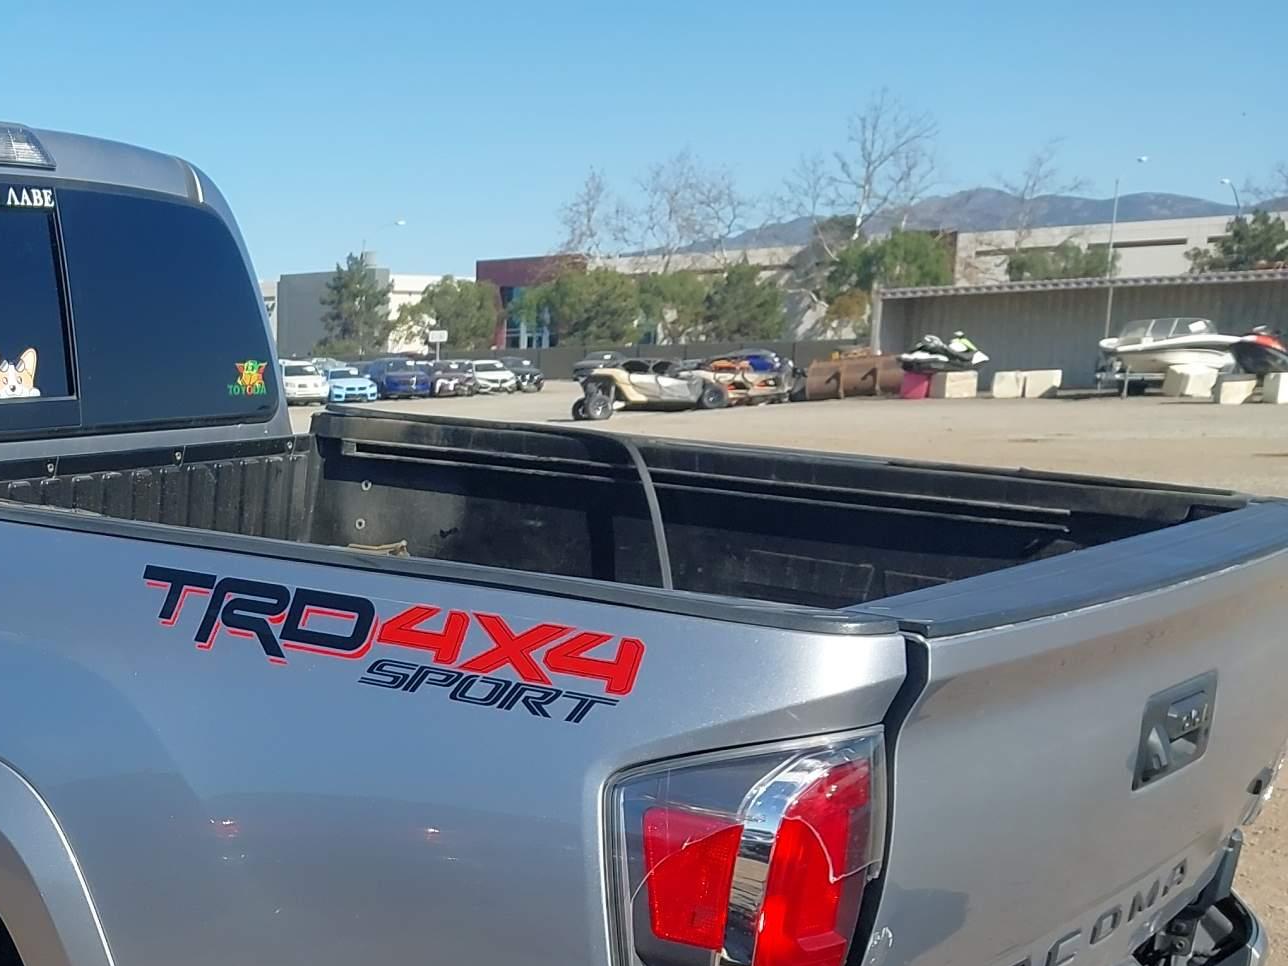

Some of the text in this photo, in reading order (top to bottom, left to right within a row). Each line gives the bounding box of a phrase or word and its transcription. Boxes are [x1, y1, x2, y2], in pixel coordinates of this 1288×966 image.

[226, 383, 267, 396] TOYODA
[143, 564, 647, 697] TRD 4X4
[357, 658, 620, 724] SPORT
